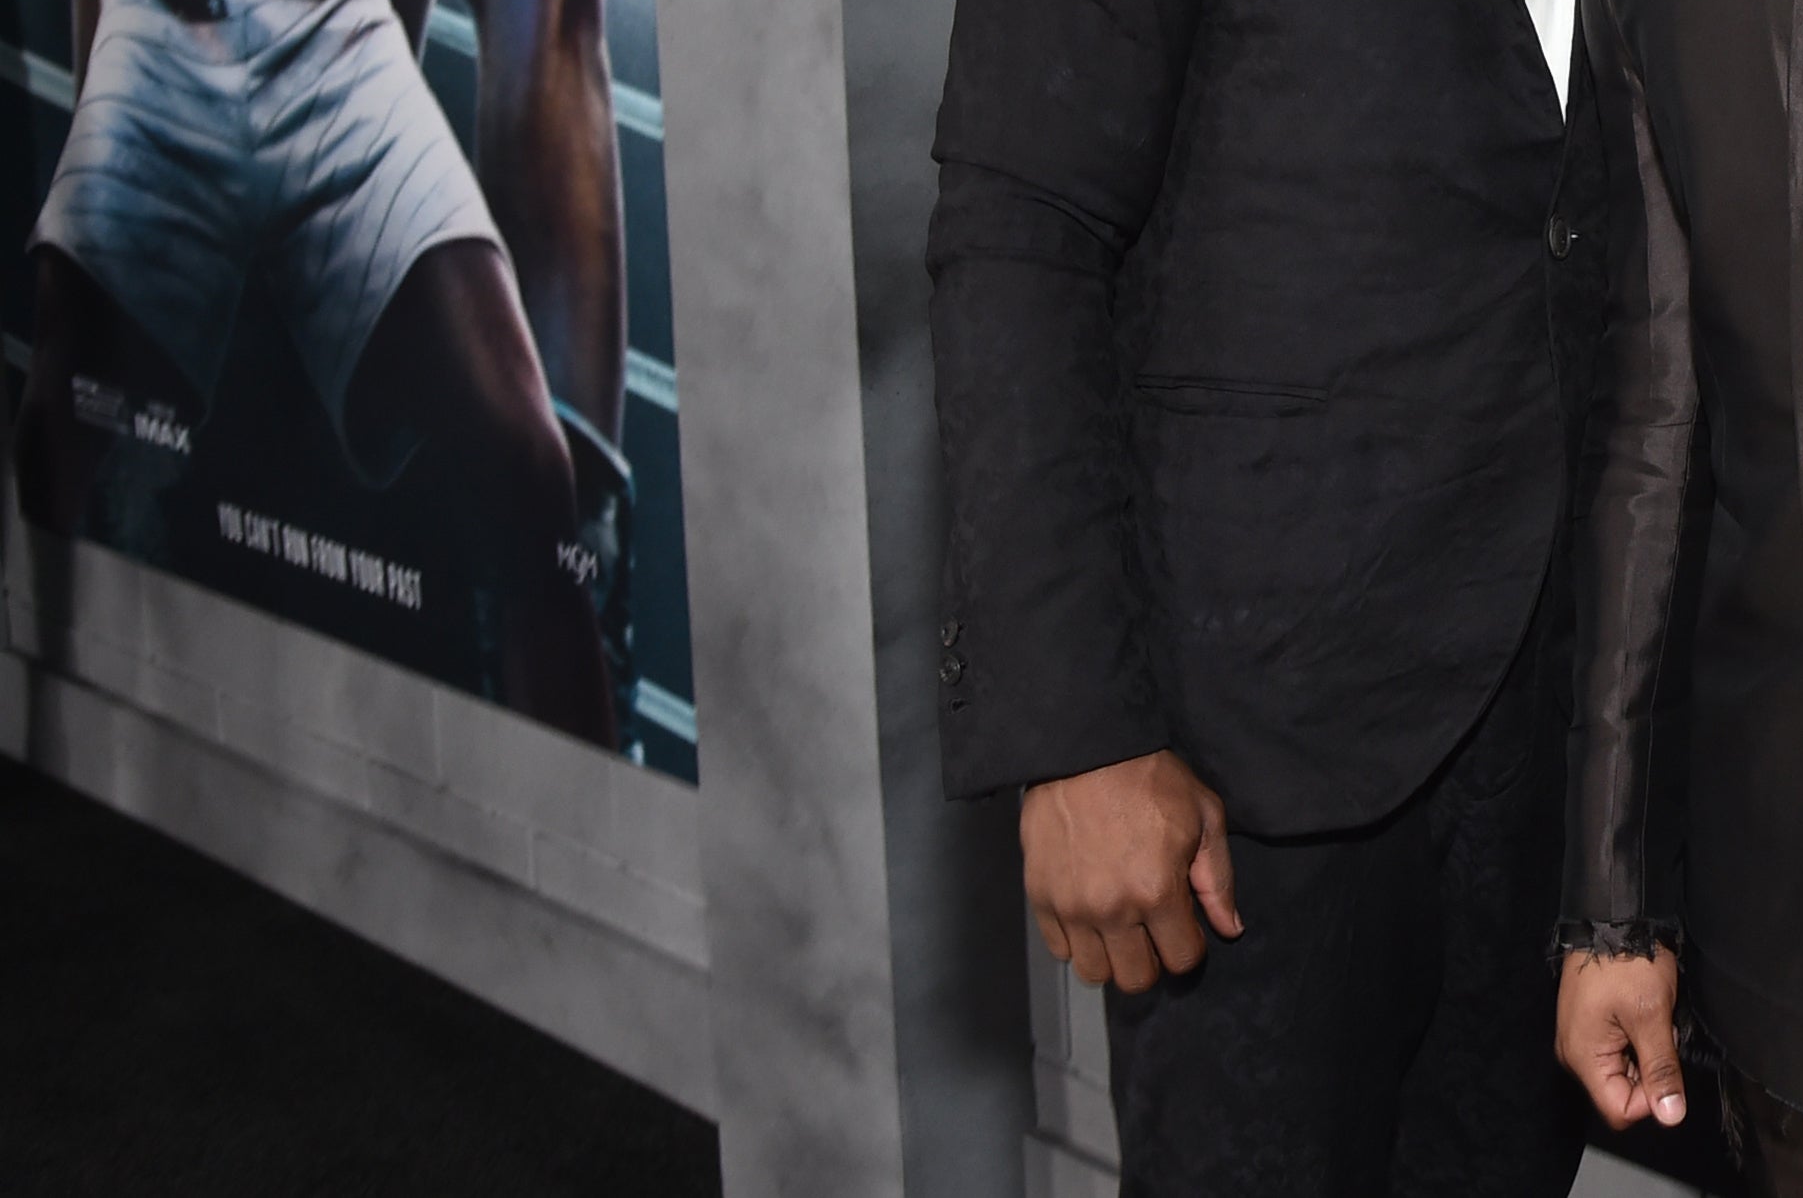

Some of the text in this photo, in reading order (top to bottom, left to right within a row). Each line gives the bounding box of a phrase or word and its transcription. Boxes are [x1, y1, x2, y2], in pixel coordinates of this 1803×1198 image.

[217, 501, 422, 611] YOU CAN'T RUN FROM YOUR PAST
